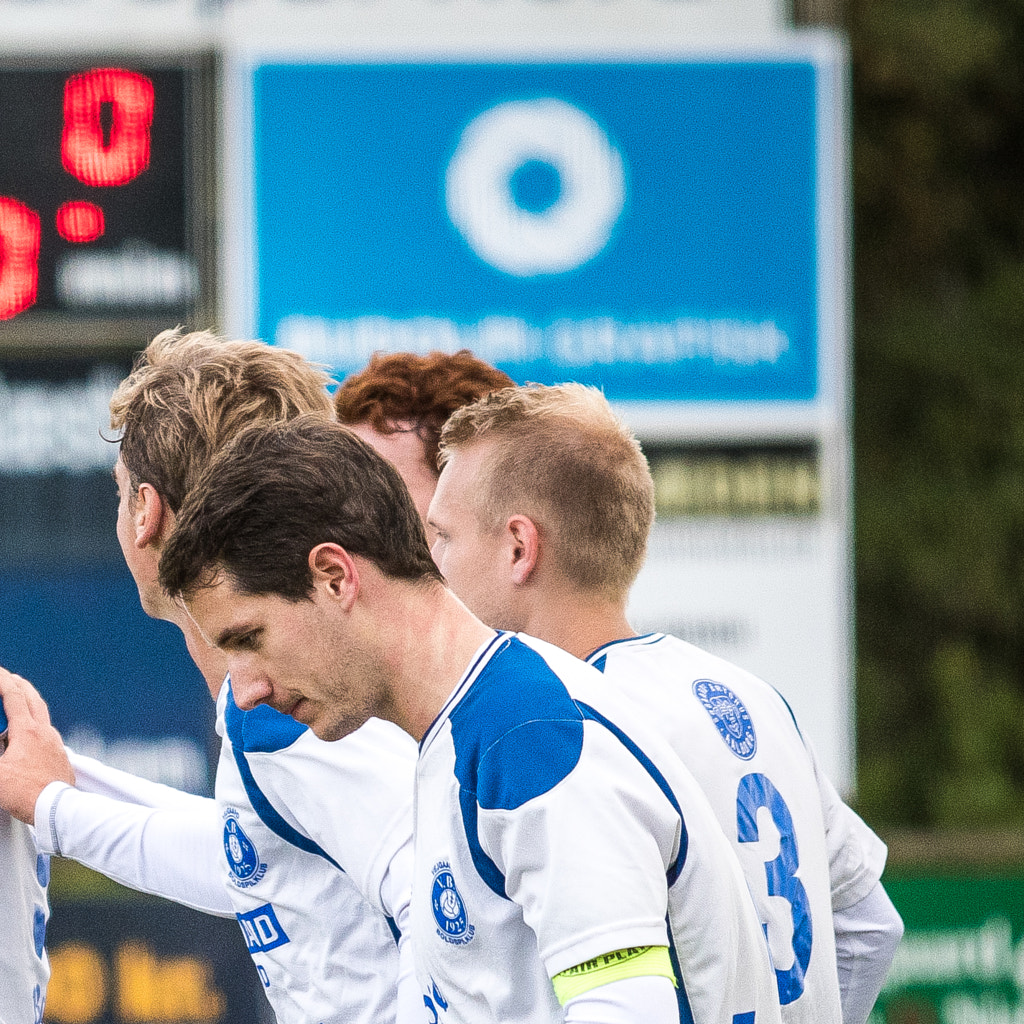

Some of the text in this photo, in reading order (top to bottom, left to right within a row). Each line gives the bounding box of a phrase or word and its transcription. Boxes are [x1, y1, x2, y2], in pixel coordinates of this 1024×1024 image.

[61, 67, 155, 187] 0
[737, 773, 813, 1006] 3
[602, 946, 646, 965] PLA
